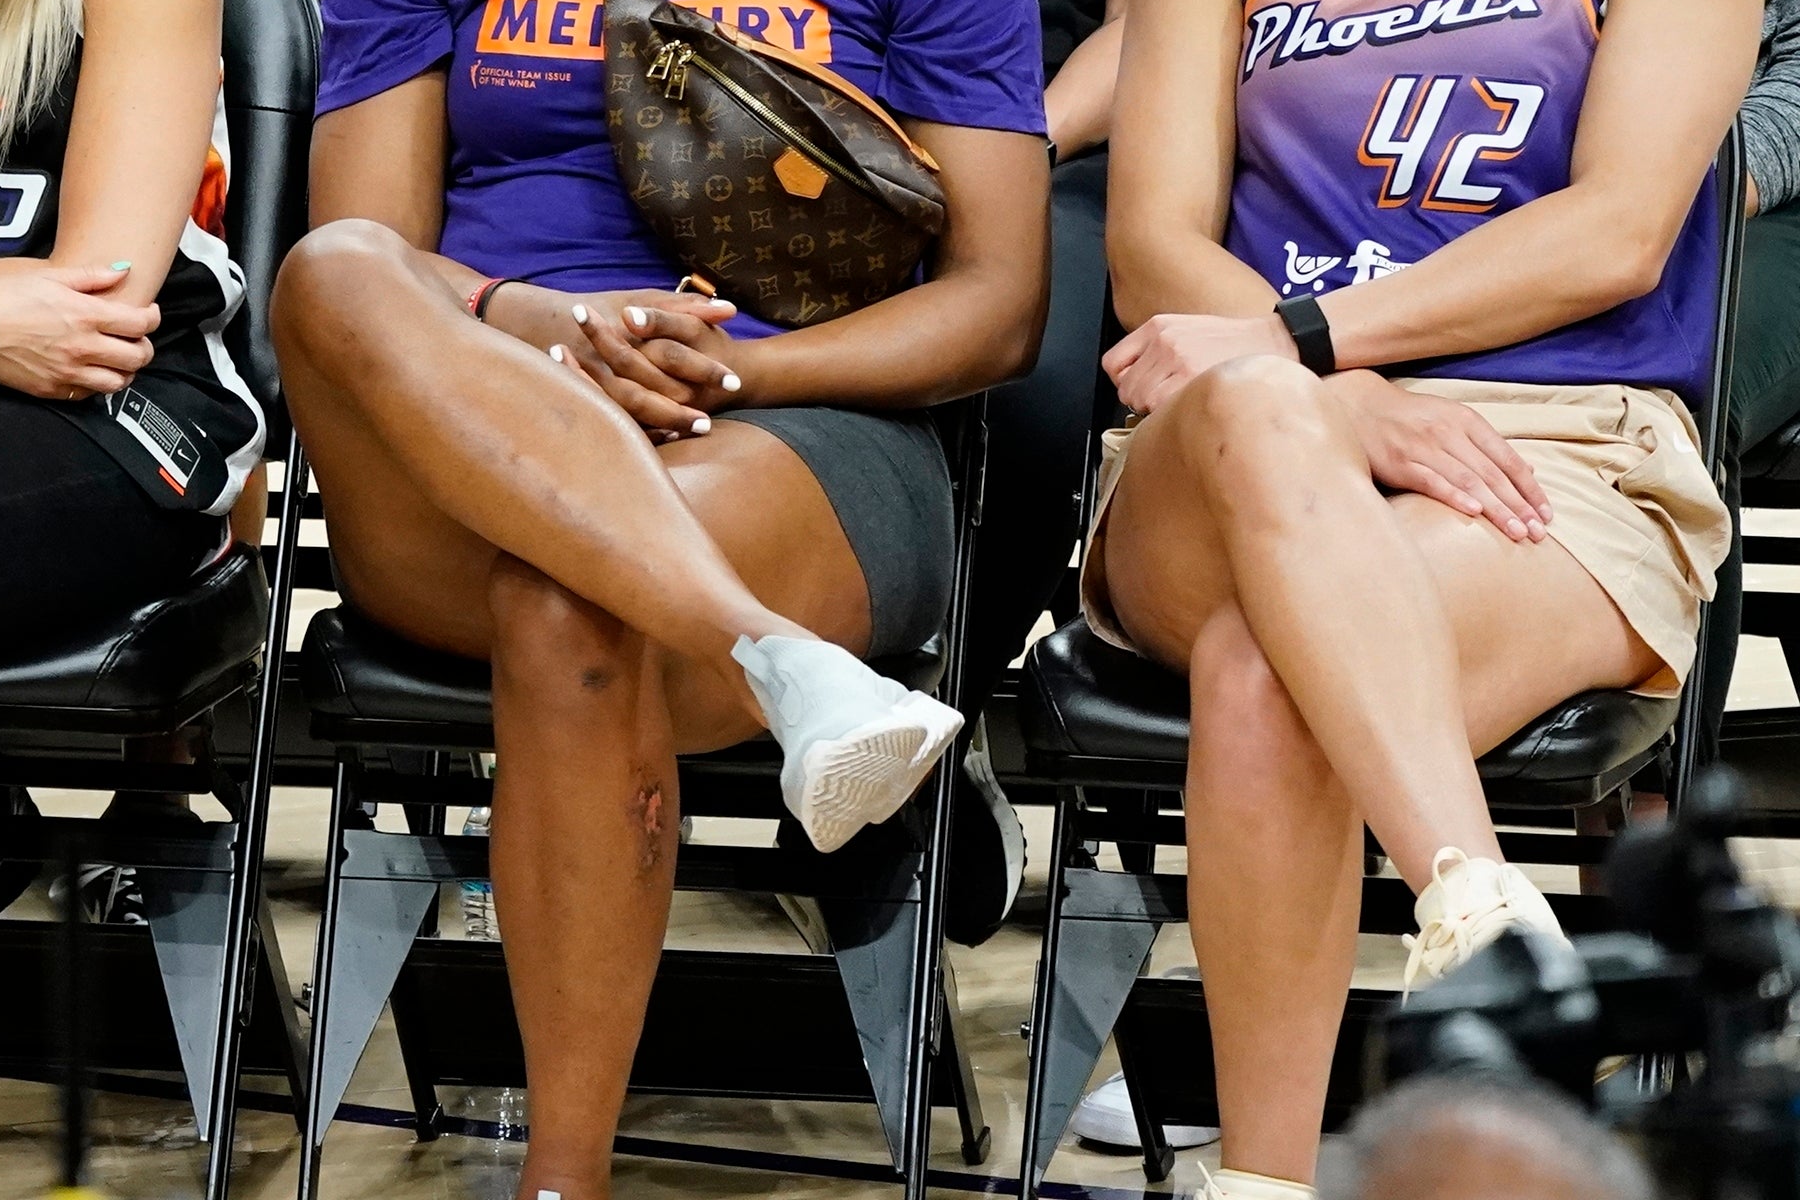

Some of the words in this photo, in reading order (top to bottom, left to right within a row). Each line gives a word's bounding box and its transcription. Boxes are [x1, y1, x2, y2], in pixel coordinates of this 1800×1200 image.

[480, 67, 514, 78] OFFICIAL
[517, 70, 541, 80] TEAM
[545, 72, 571, 82] ISSUE
[479, 76, 490, 85] OF
[491, 78, 505, 87] THE
[508, 79, 536, 89] WNBA
[1357, 74, 1546, 213] 42
